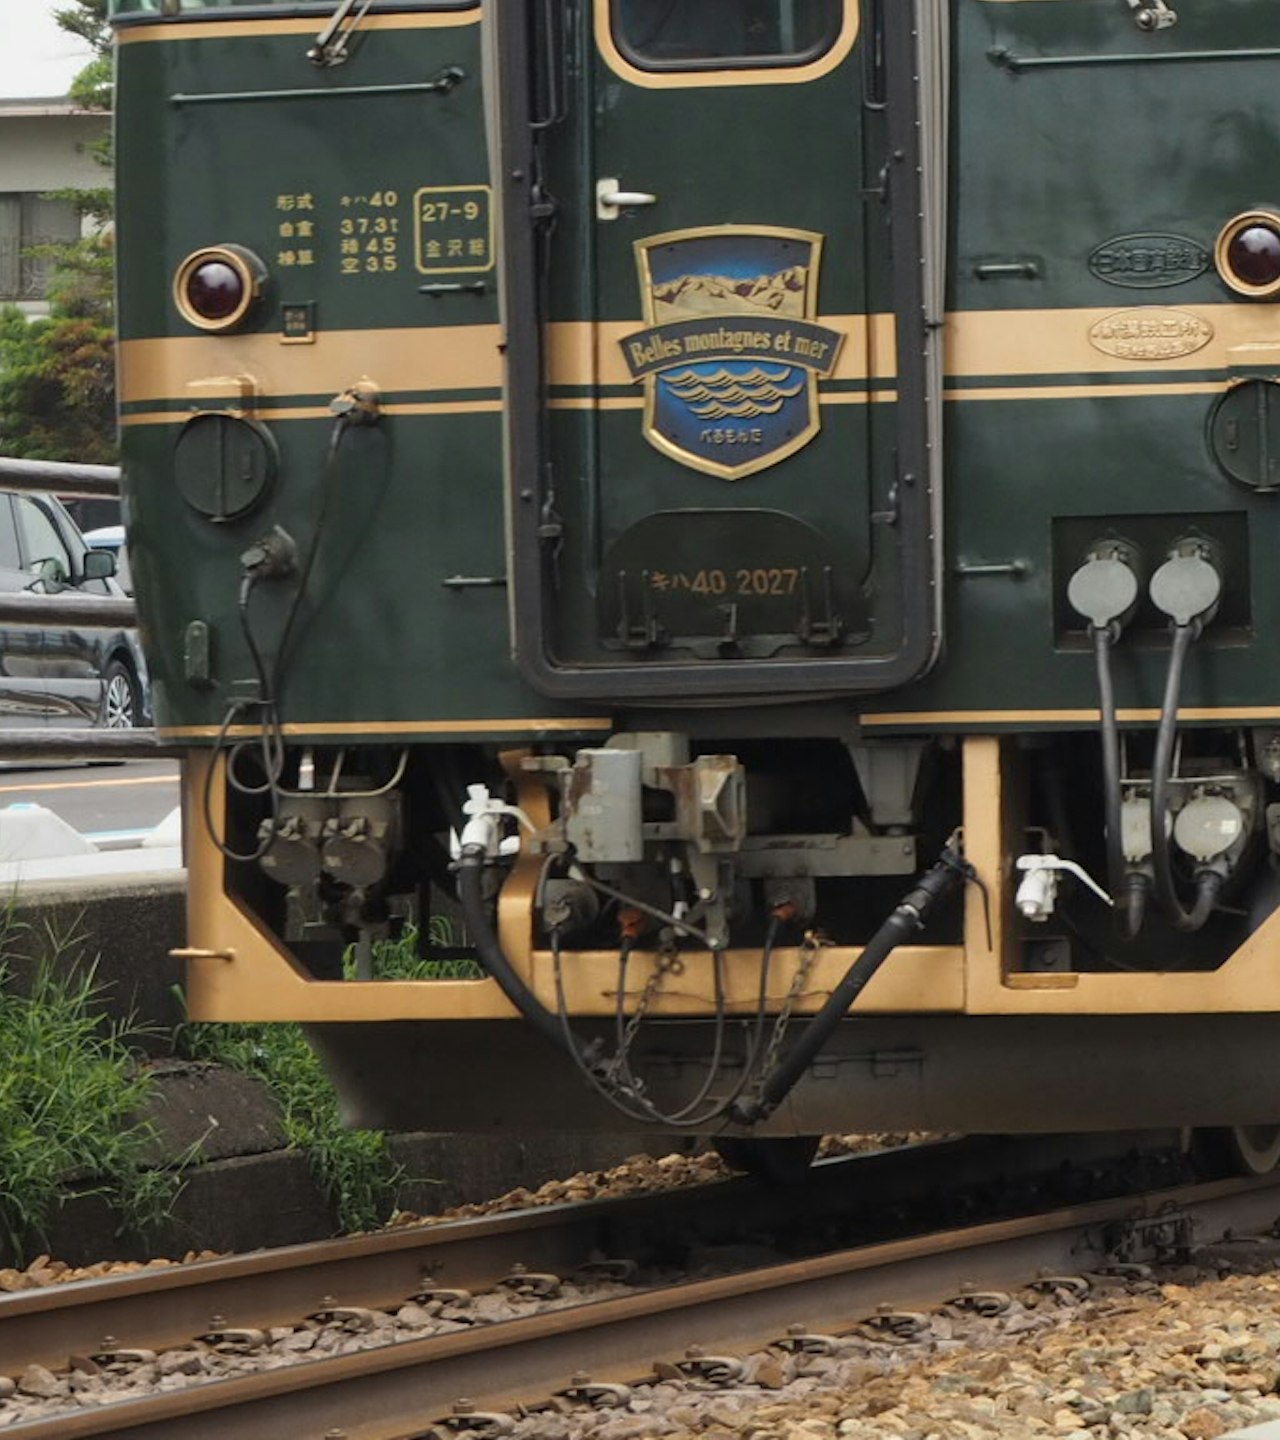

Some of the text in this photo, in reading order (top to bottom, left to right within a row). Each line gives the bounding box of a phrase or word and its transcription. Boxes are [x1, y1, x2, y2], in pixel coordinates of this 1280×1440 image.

[276, 192, 315, 211] 形式
[422, 200, 479, 223] 27-9
[629, 327, 829, 368] Belles montagnes et mer
[650, 568, 799, 595] キハ40 2027
